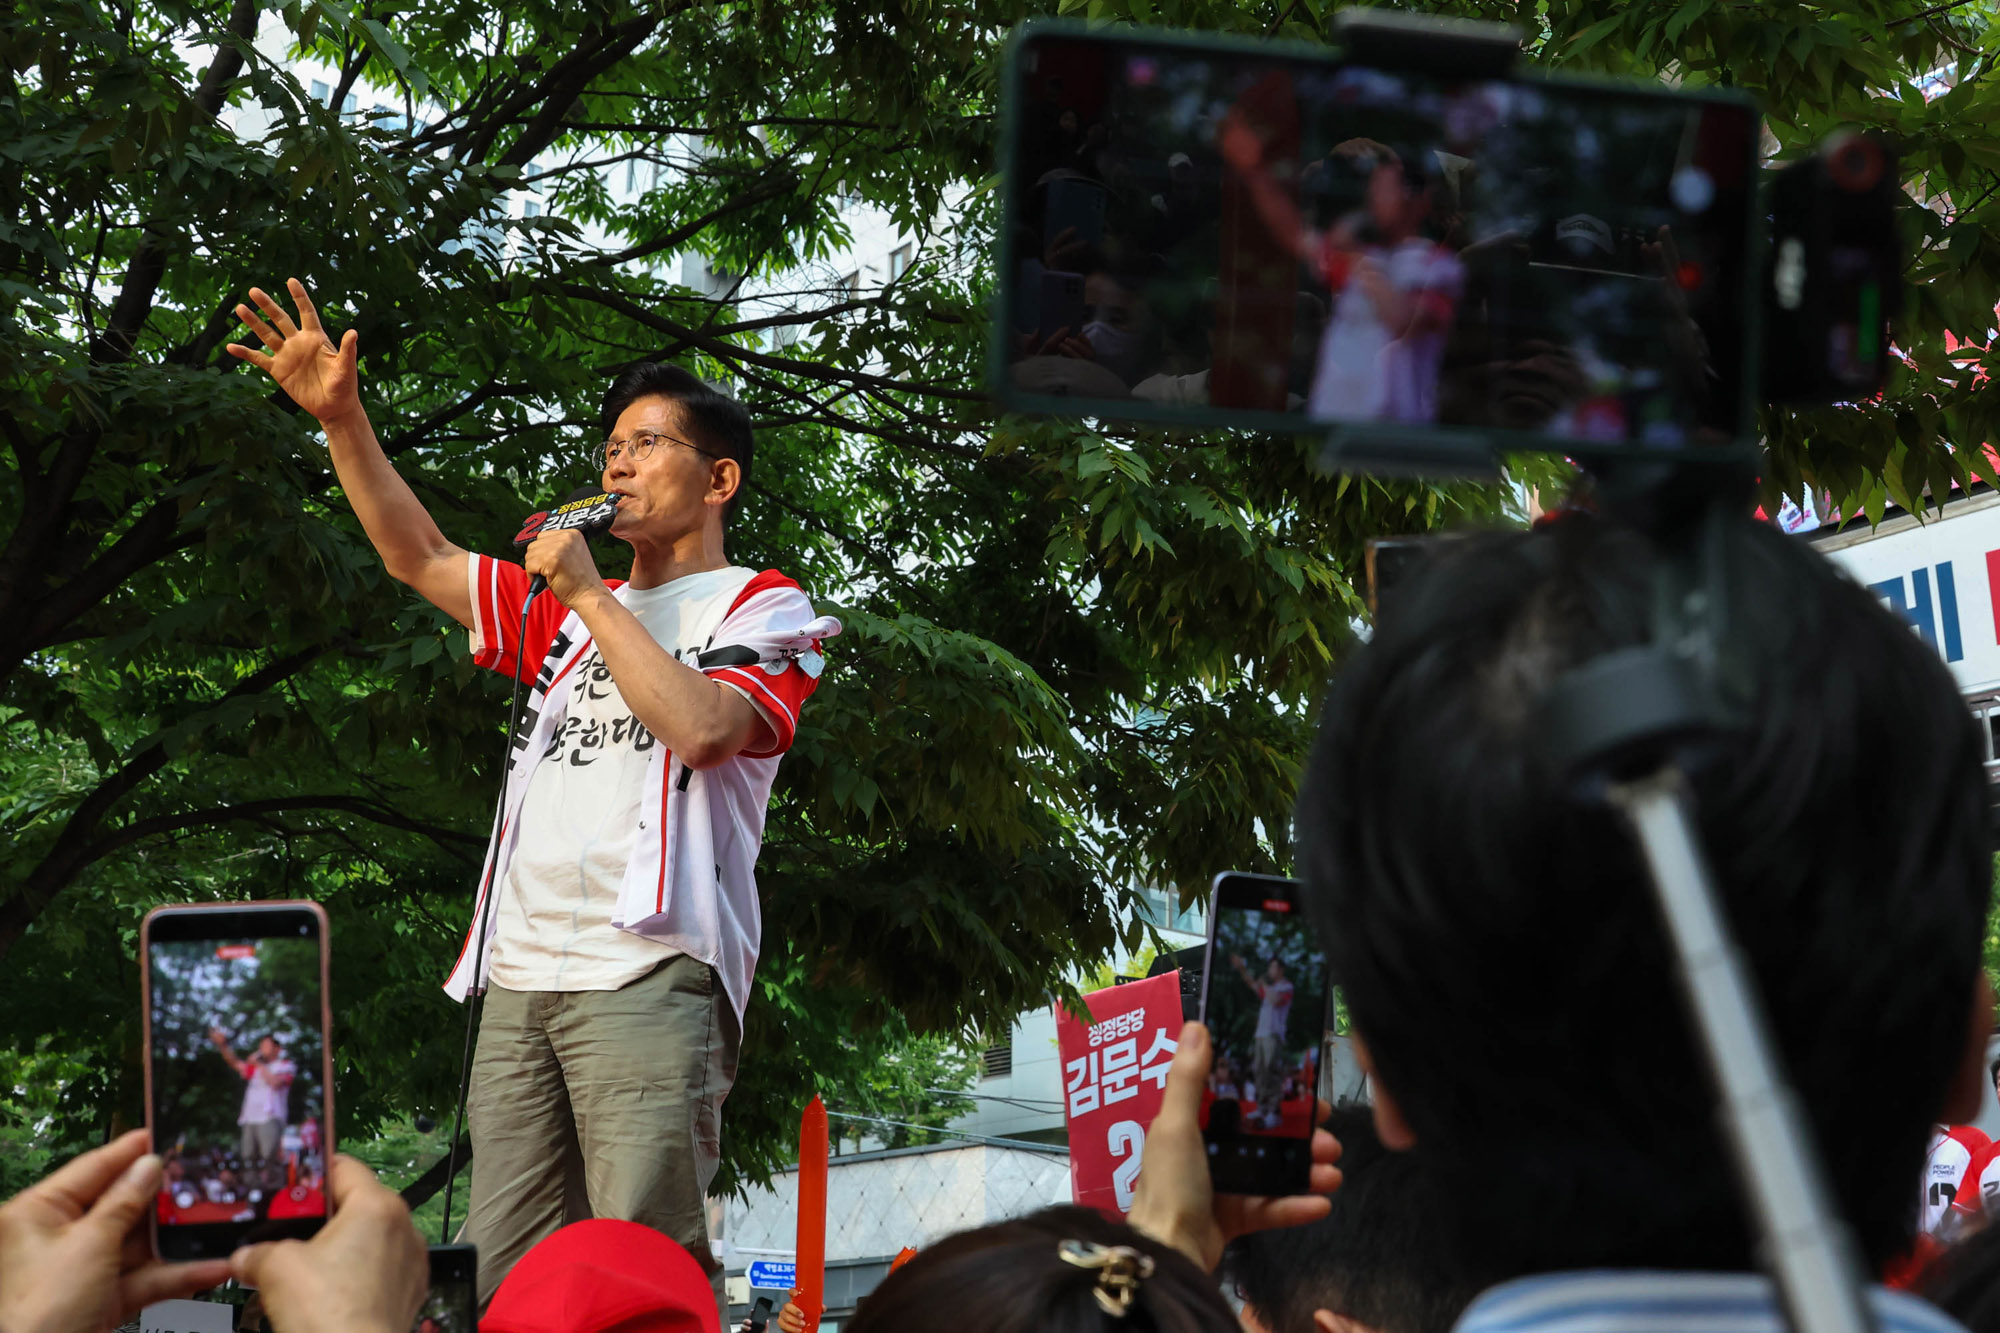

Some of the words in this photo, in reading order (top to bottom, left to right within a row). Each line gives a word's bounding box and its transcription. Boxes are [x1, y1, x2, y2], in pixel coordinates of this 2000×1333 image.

[514, 511, 549, 542] 2
[1066, 1027, 1179, 1119] 김문수
[1107, 1120, 1146, 1214] 2
